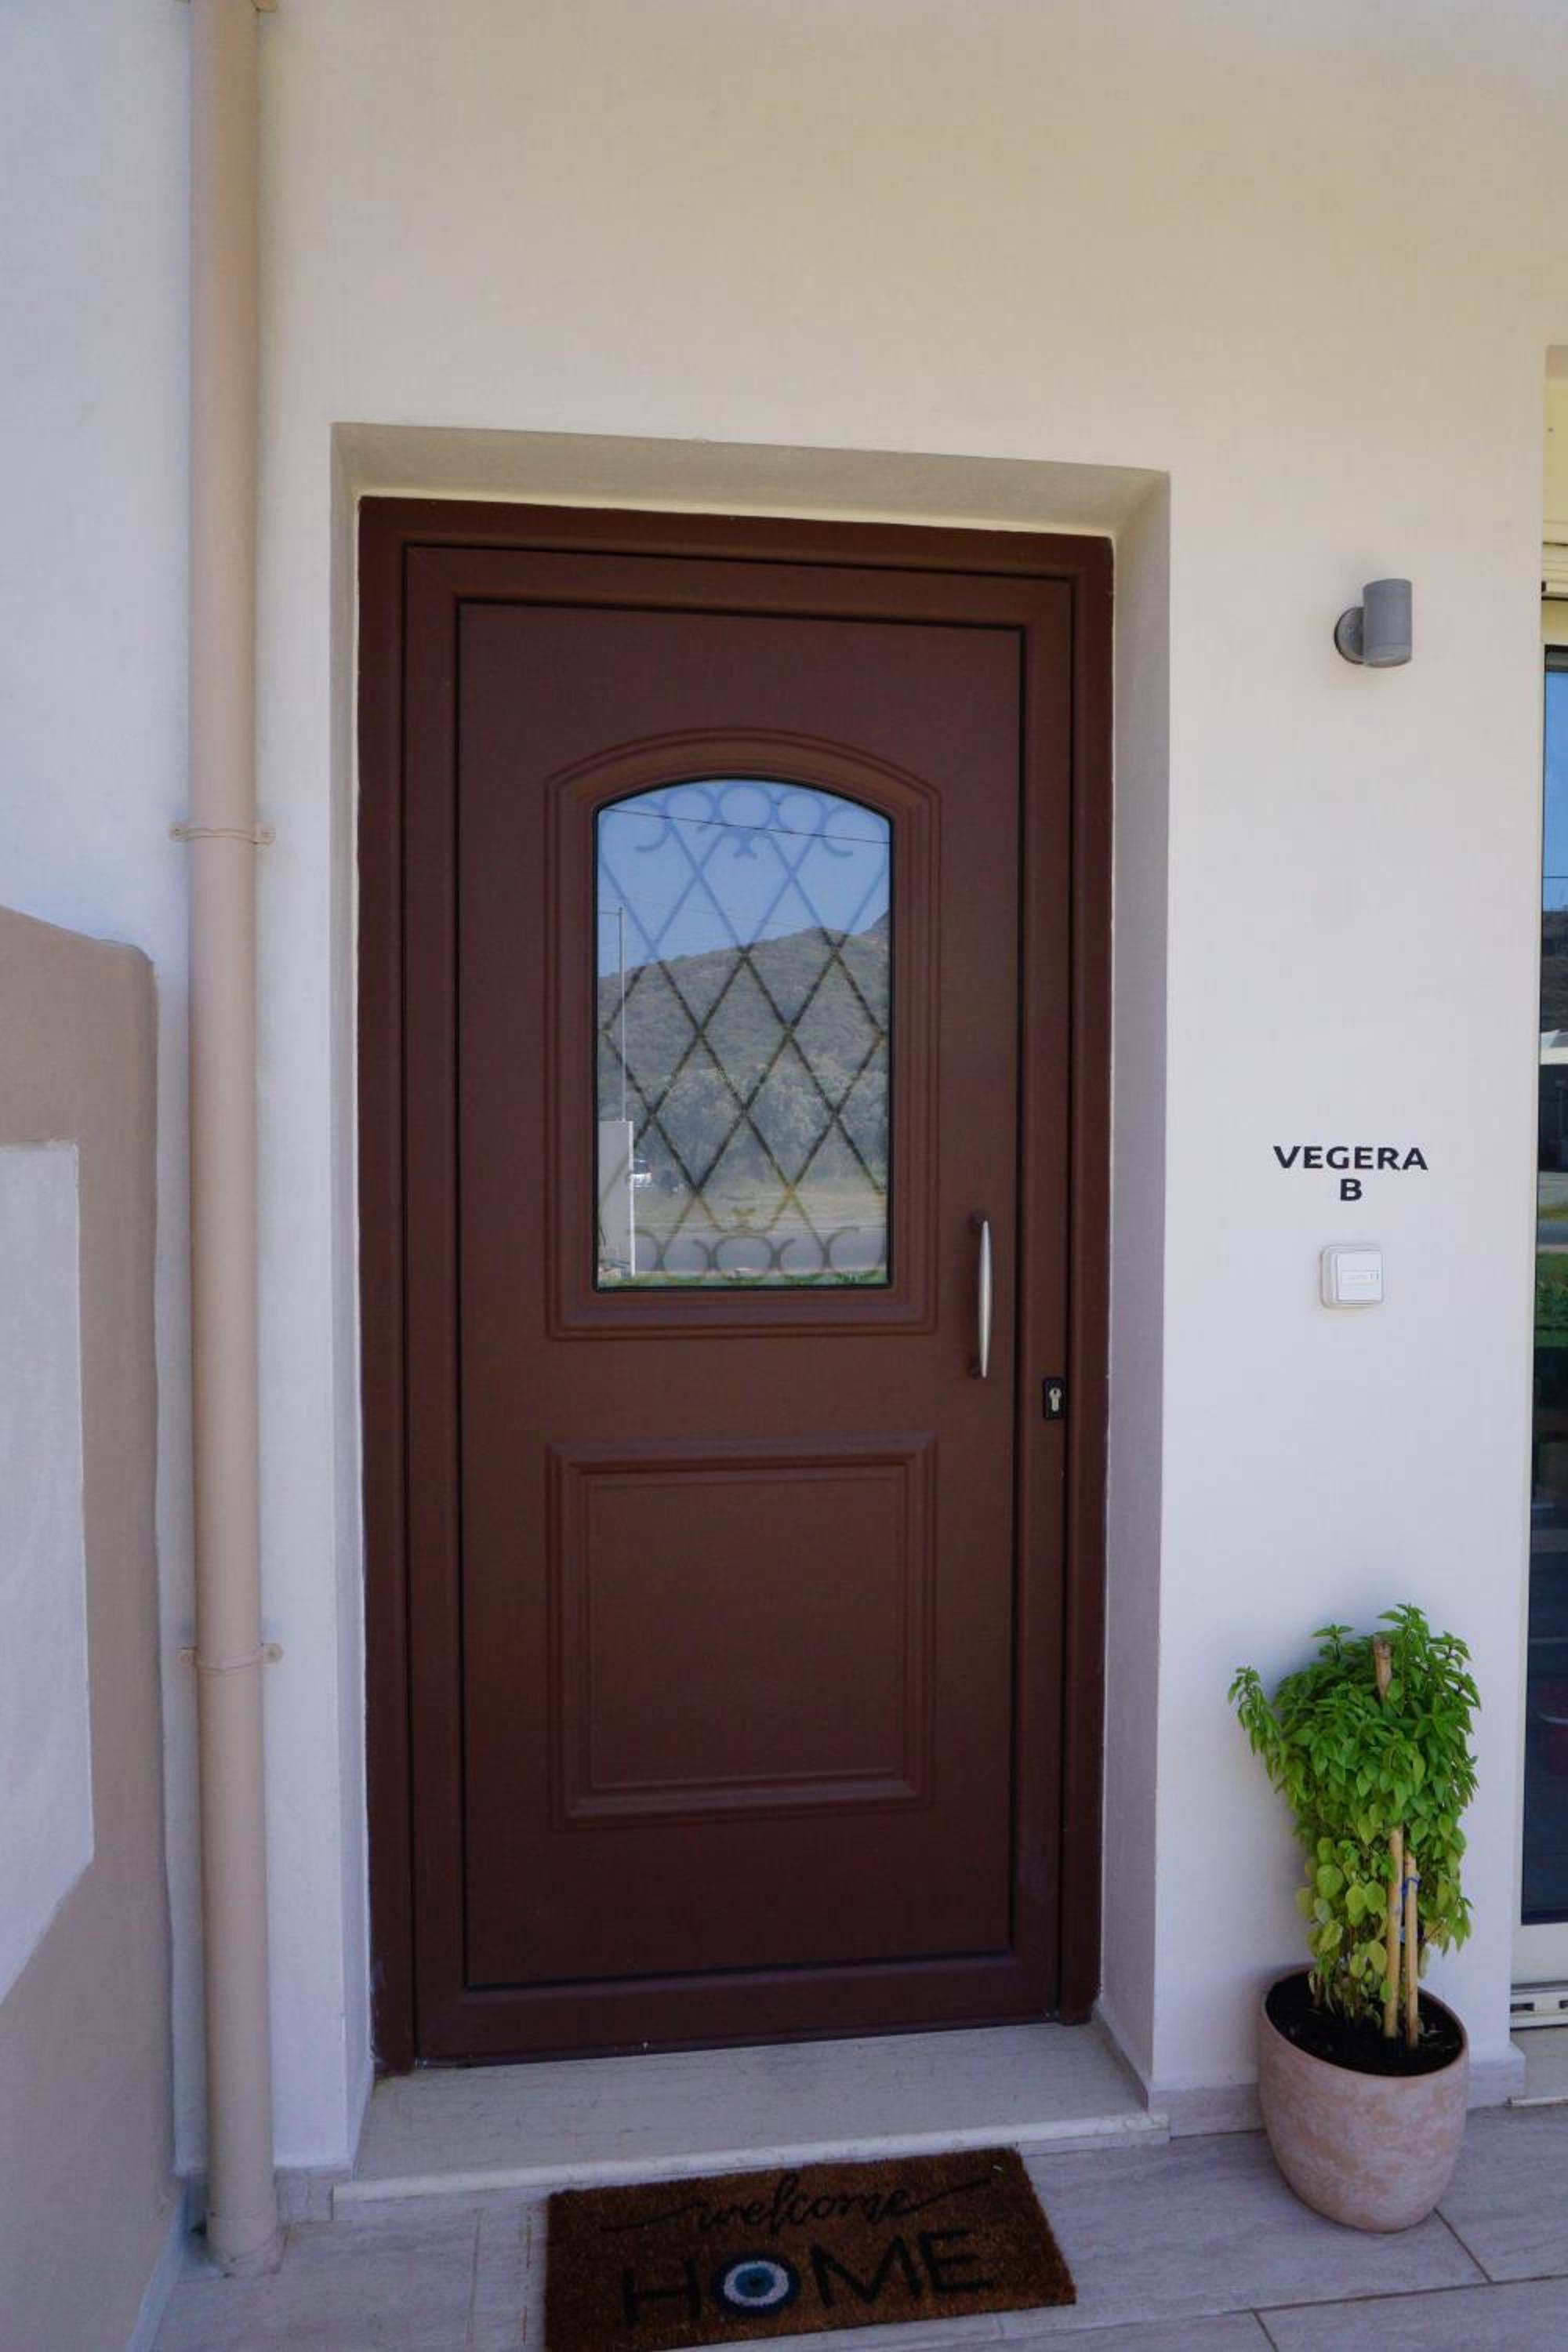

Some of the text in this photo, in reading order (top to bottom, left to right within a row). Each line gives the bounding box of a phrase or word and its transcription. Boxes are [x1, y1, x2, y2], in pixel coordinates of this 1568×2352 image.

[1273, 1145, 1428, 1171] VEGERA
[1340, 1178, 1363, 1201] B
[602, 2173, 992, 2234] welcome
[621, 2229, 996, 2328] HOME
